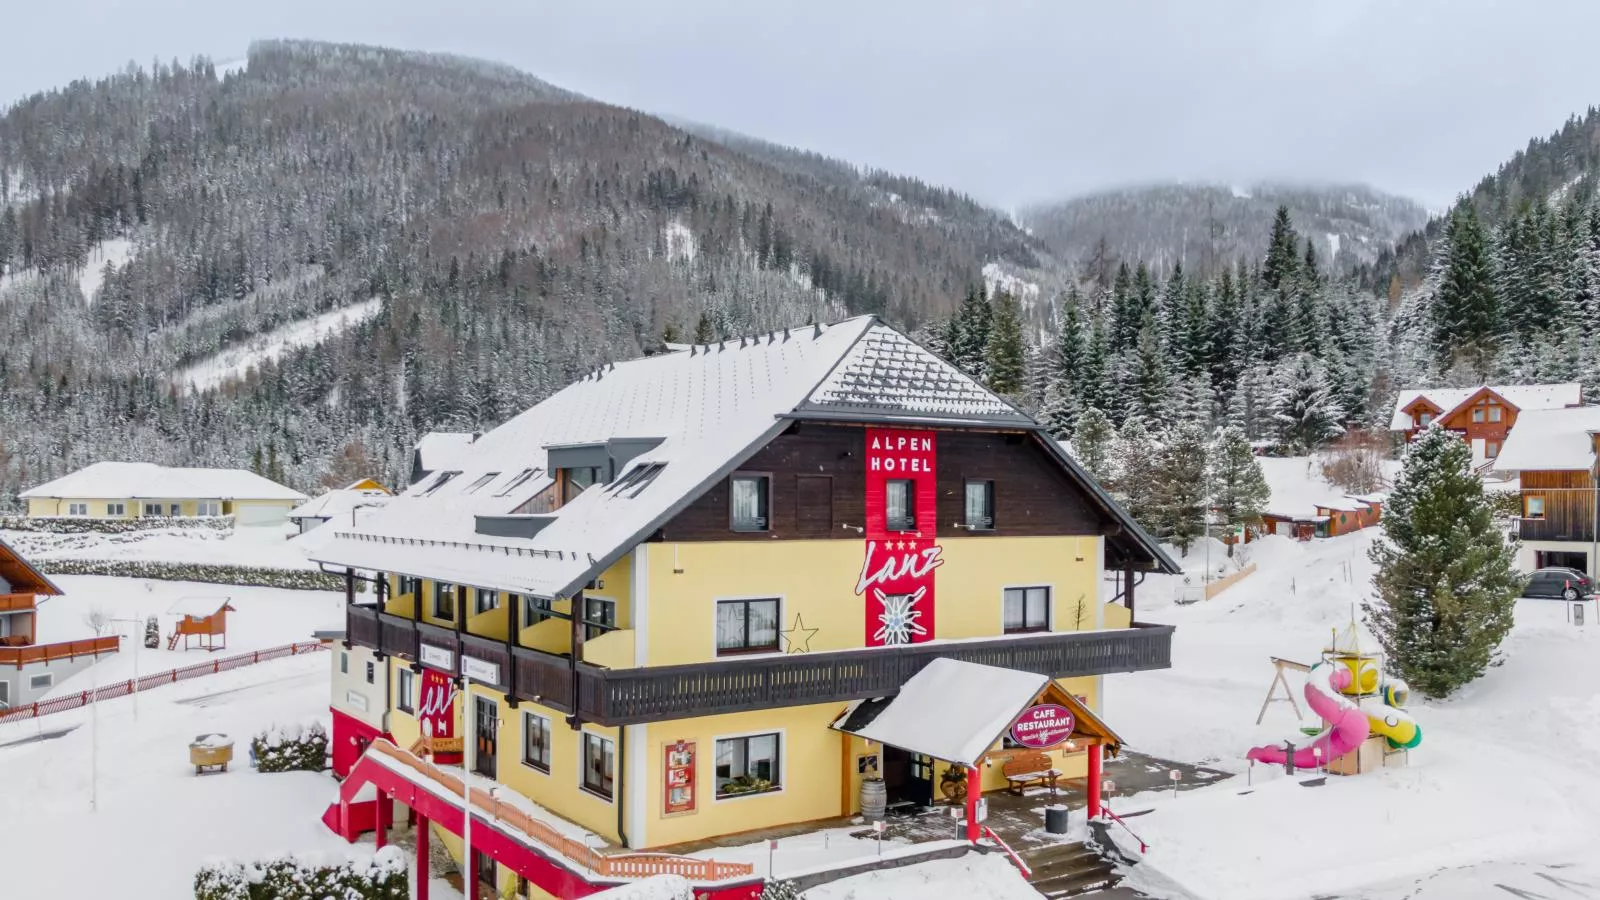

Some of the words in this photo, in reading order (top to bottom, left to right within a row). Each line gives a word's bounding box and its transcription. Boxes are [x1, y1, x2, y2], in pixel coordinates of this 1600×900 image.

[871, 436, 931, 451] ALPEN
[871, 457, 931, 472] HOTEL
[855, 541, 944, 596] Lanz
[1033, 709, 1055, 719] CAFE
[1017, 717, 1070, 731] RESTAURANT
